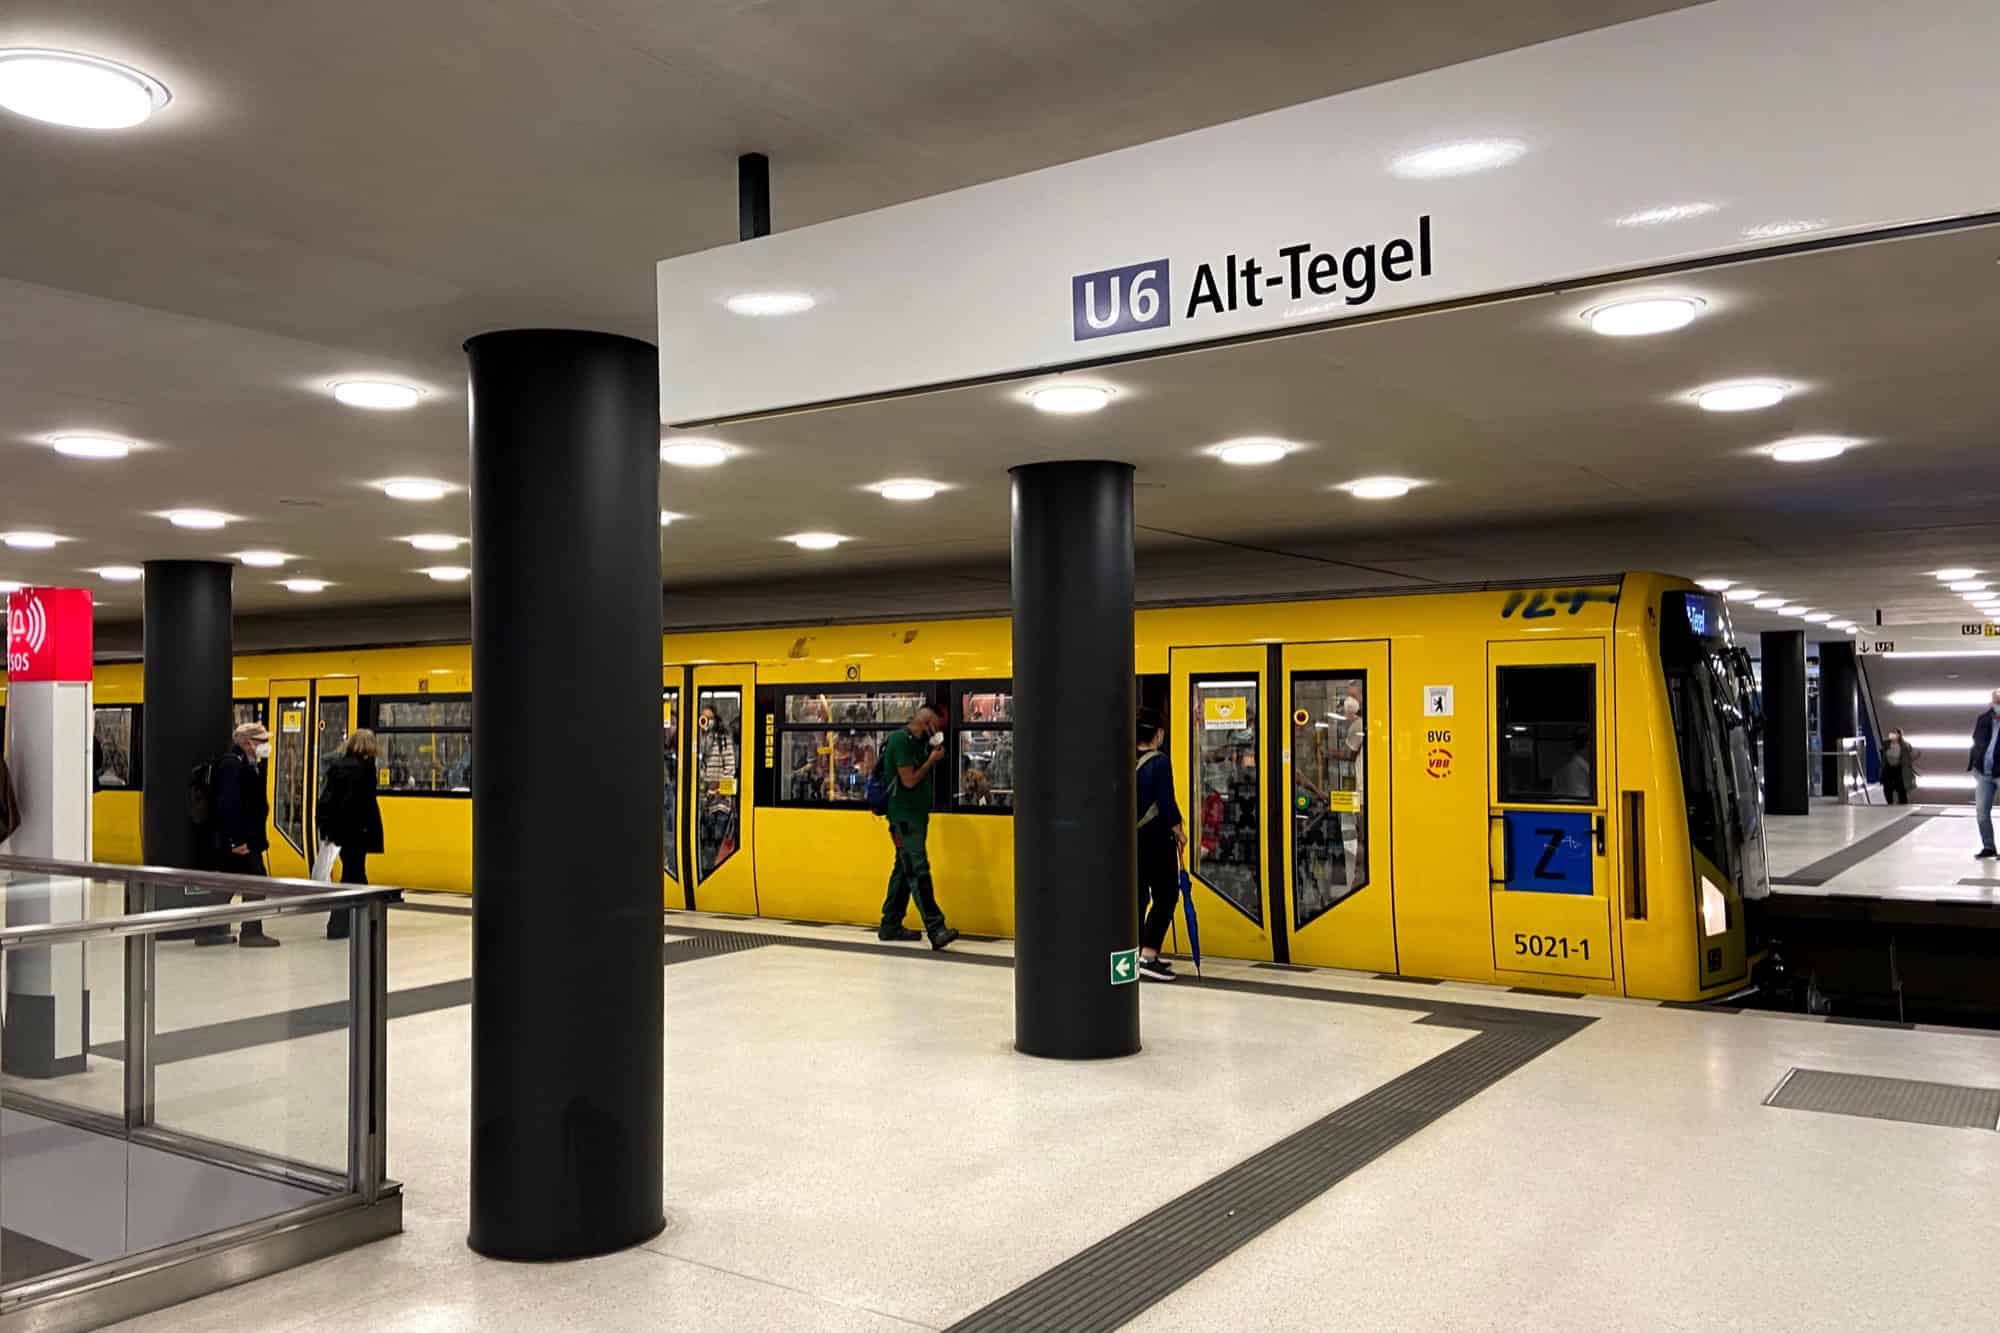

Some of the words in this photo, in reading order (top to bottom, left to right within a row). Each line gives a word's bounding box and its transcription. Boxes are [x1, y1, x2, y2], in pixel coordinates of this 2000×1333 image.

[1084, 269, 1160, 330] U6
[1185, 215, 1432, 319] Alt-Tegel
[10, 653, 29, 671] SOS
[1427, 729, 1451, 743] BVG
[1534, 827, 1566, 880] Z
[1514, 933, 1590, 961] 5021-1
